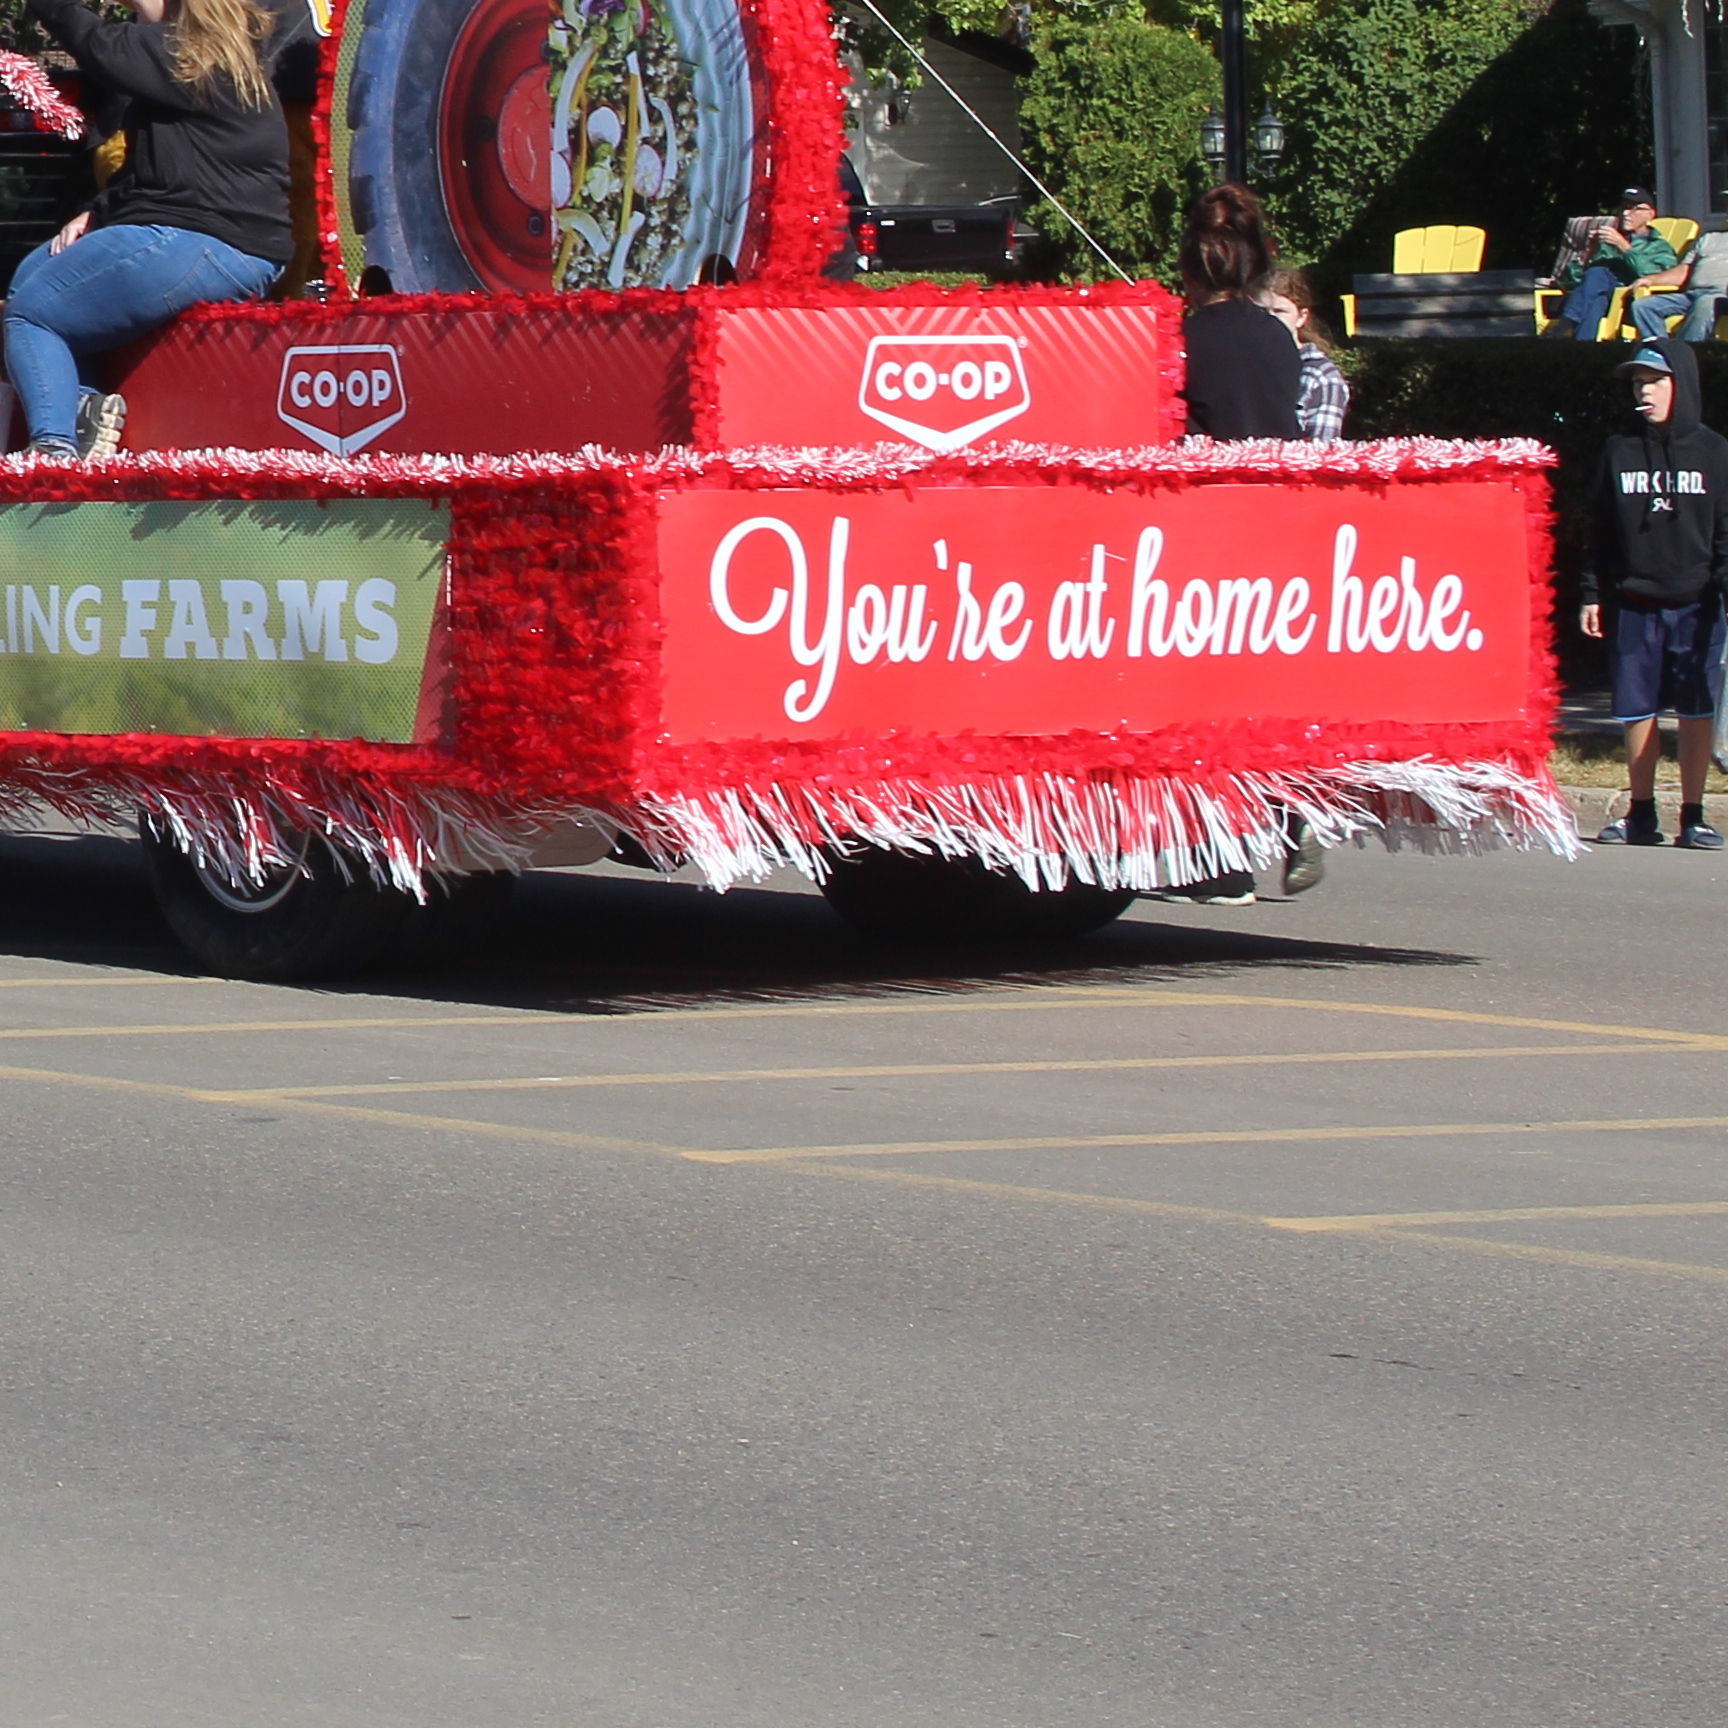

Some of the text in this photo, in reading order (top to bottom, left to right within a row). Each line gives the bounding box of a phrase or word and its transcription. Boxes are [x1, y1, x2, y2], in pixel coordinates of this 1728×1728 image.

[290, 369, 392, 408] CO-OP
[875, 361, 1012, 401] CO-OP
[1620, 471, 1662, 494] WRK
[120, 578, 400, 665] FARMS
[709, 516, 1484, 722] You're at home here.
